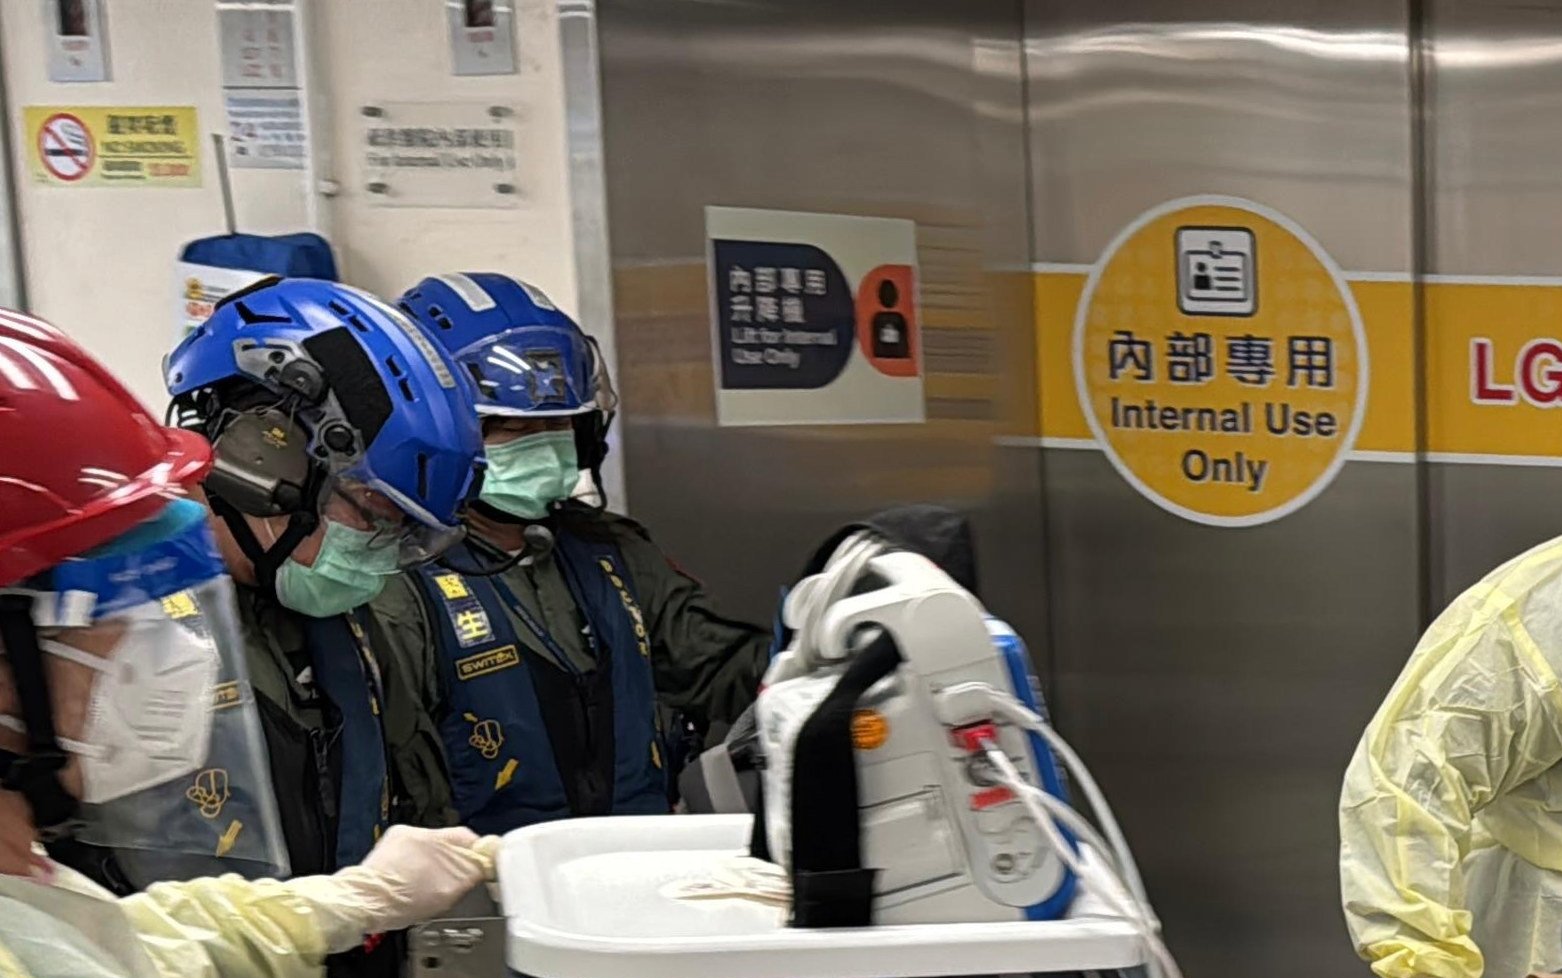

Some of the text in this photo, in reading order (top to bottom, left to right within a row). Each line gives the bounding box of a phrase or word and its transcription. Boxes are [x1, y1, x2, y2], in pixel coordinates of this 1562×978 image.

[1108, 330, 1335, 387] 內部專用
[1111, 398, 1337, 437] Internal Use
[1182, 449, 1266, 492] Only
